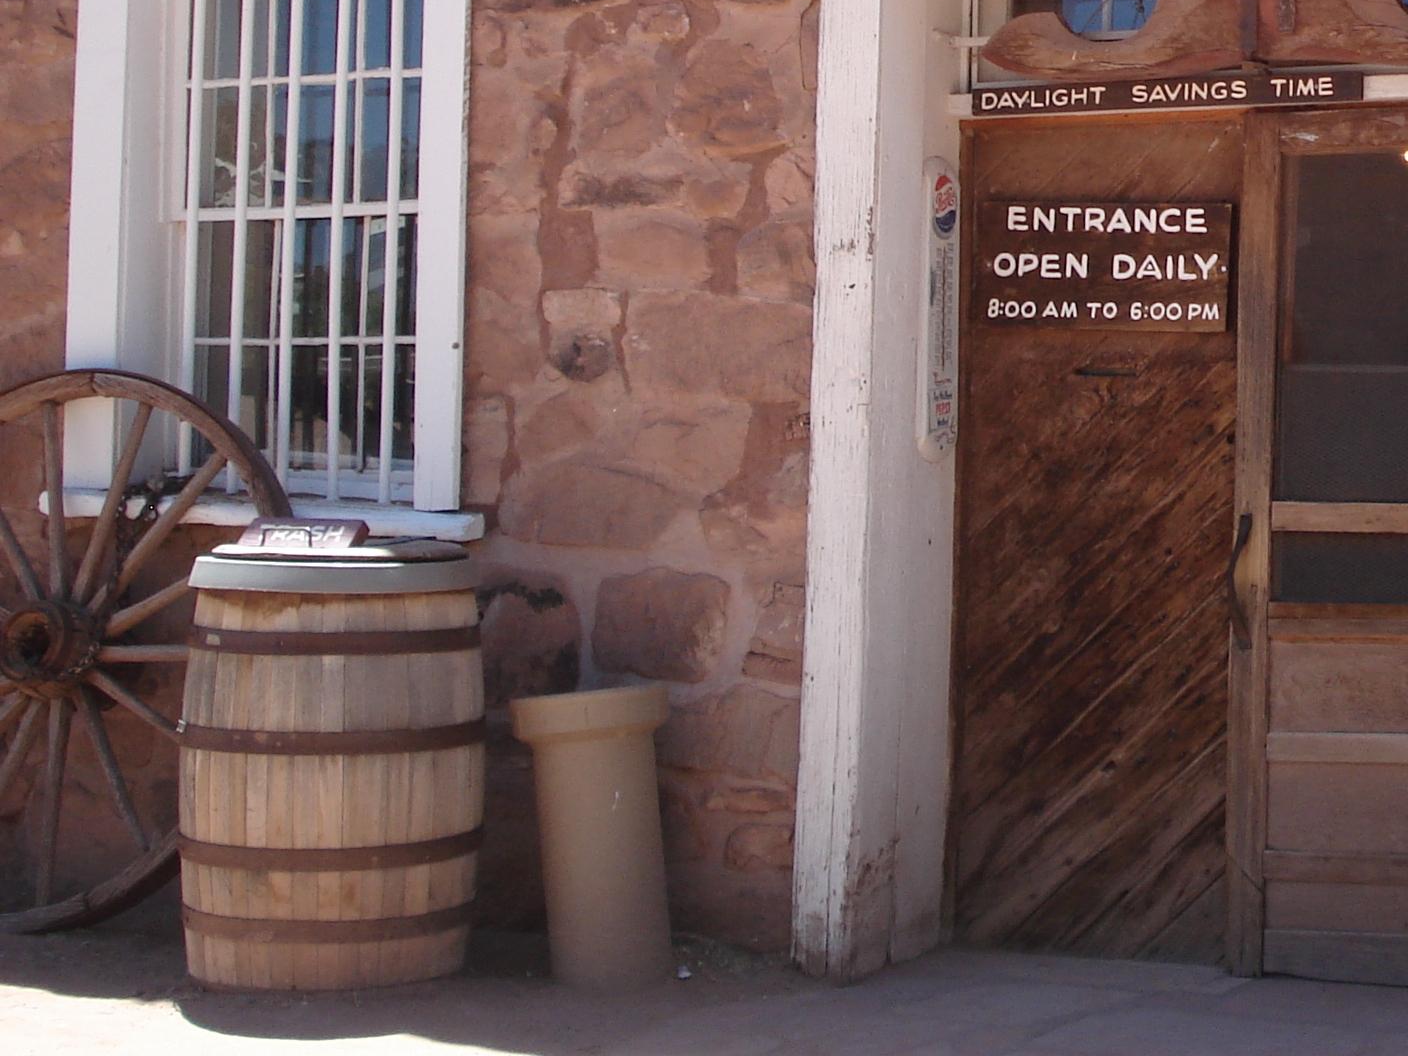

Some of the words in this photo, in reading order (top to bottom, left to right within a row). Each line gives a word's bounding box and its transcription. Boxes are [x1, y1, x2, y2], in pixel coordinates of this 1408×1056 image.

[981, 86, 1107, 111] DAYLIGHT
[1132, 80, 1247, 104] SAVINGS
[1270, 77, 1334, 97] TIME
[1007, 206, 1208, 234] ENTRANCE
[993, 252, 1088, 279] OPEN
[1112, 254, 1219, 280] DAILY
[987, 298, 1037, 318] 8:00
[1042, 301, 1077, 319] AM
[1086, 302, 1118, 319] TO
[1130, 302, 1183, 320] 6:00
[1187, 302, 1220, 321] PM
